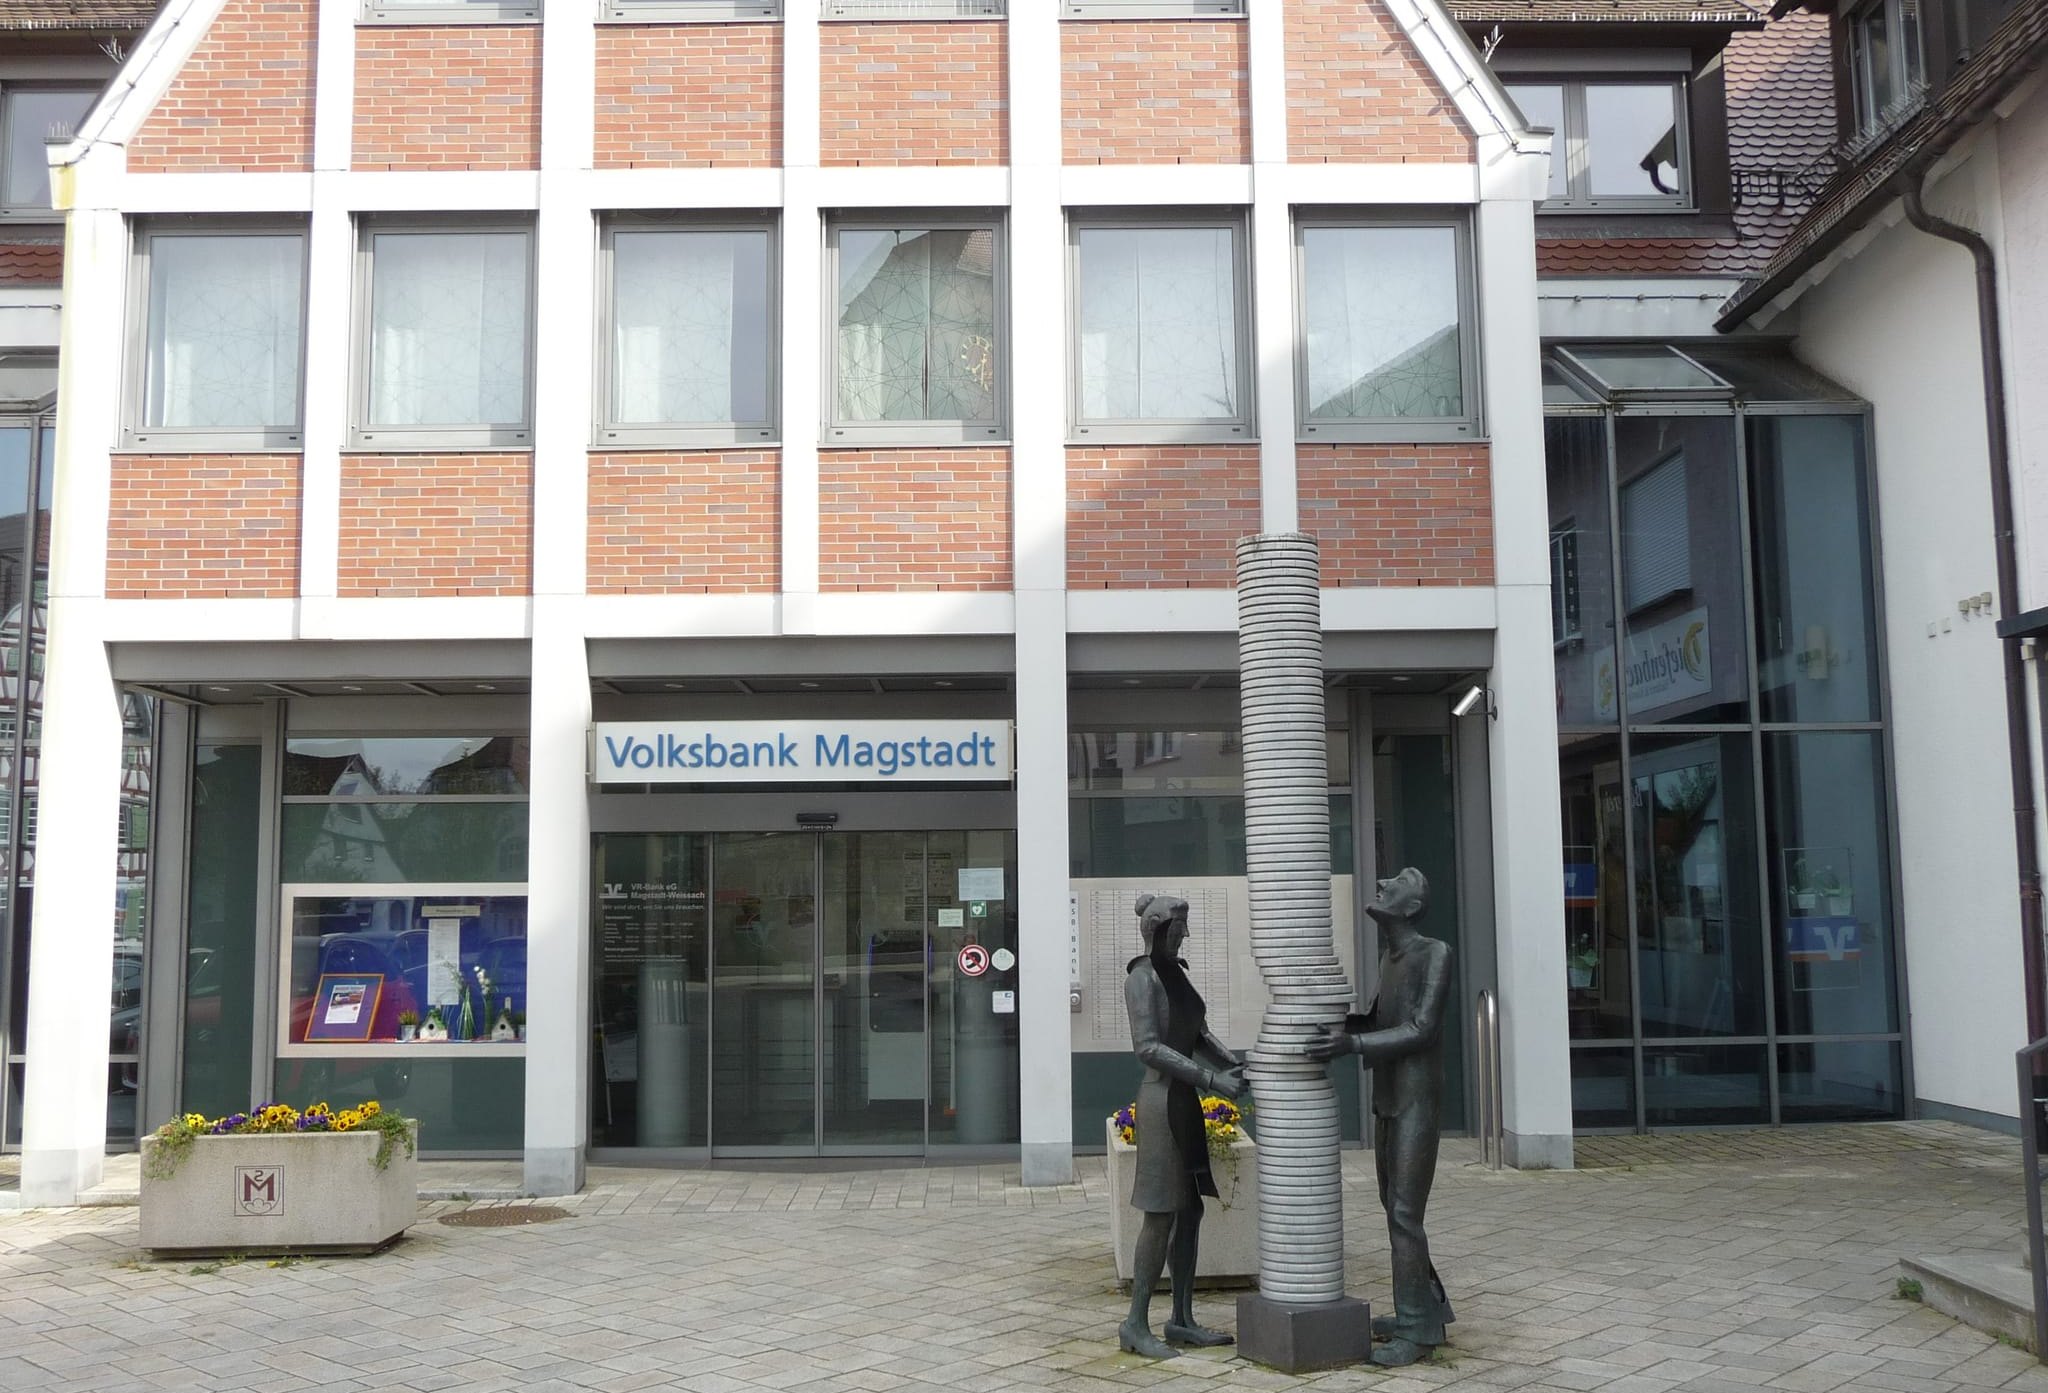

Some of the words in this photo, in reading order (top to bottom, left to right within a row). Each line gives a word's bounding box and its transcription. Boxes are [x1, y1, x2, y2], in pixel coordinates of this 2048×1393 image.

[605, 732, 799, 768] Volksbank
[815, 732, 996, 775] Magstadt
[631, 892, 705, 900] Magstadt-Weissach
